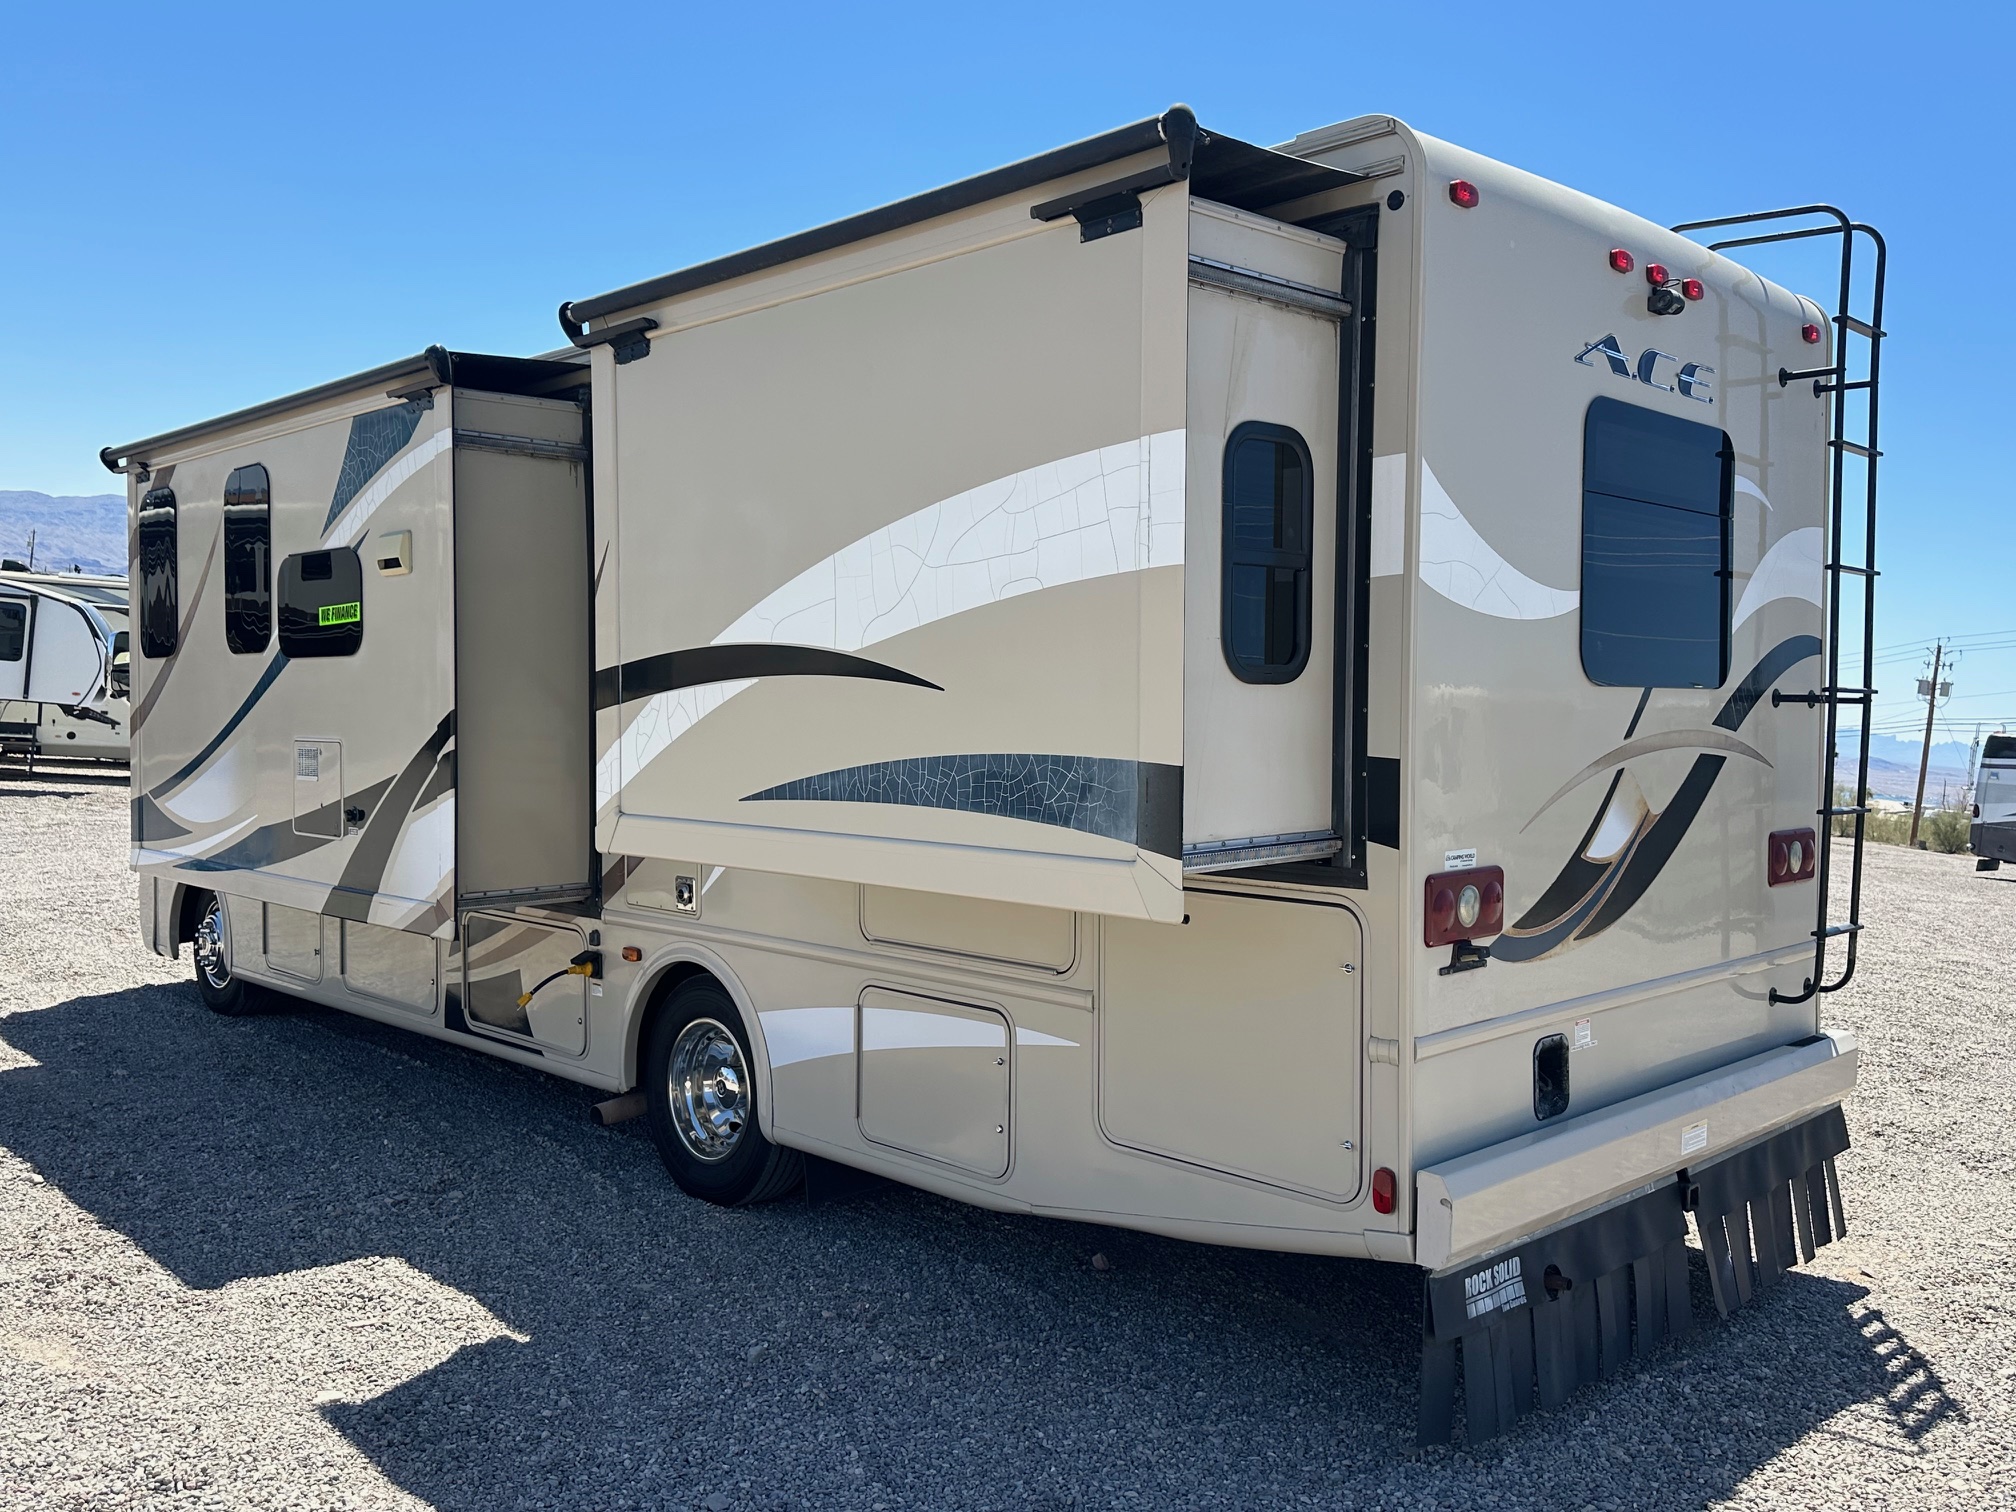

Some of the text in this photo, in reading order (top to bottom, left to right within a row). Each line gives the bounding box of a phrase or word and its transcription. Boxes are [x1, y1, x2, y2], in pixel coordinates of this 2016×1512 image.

[321, 603, 359, 623] WE FINANCE
[1464, 1256, 1521, 1299] ROCK SOLID
